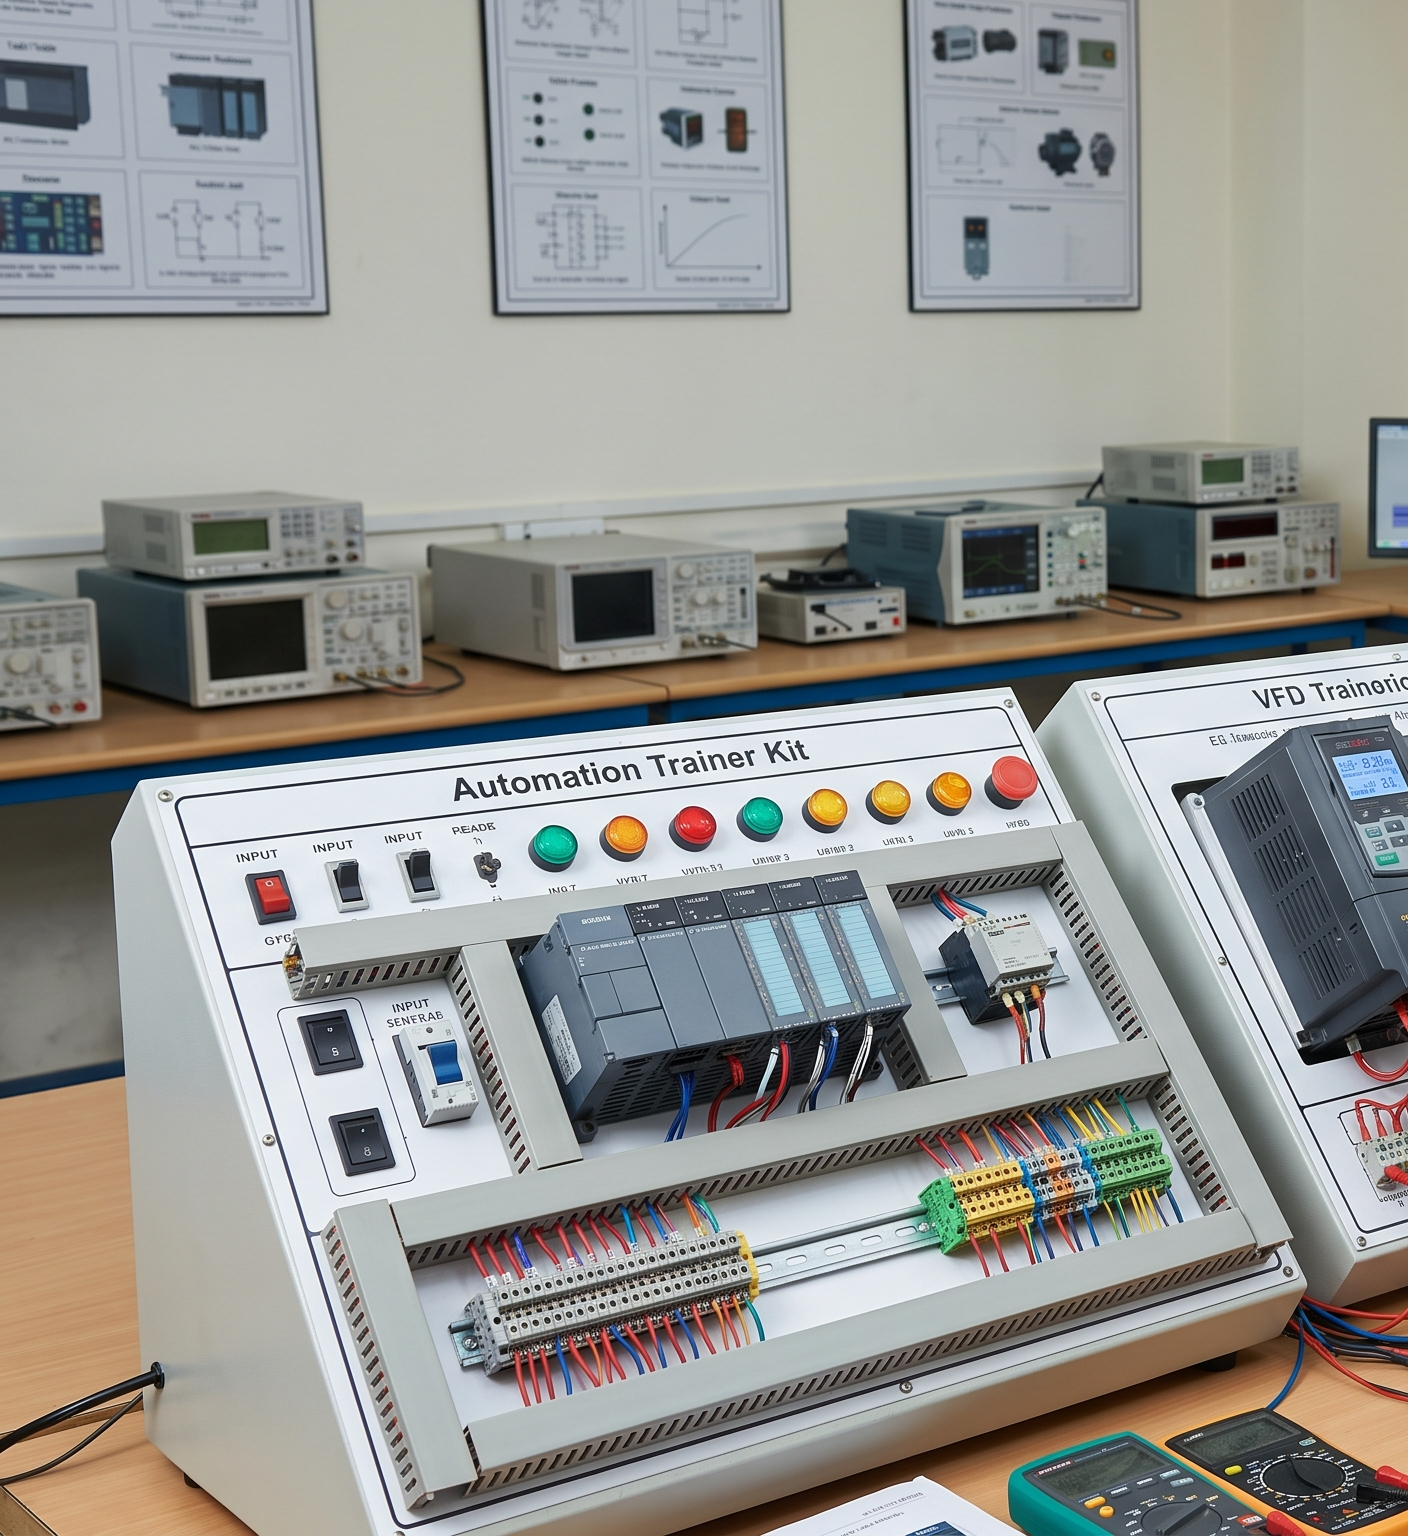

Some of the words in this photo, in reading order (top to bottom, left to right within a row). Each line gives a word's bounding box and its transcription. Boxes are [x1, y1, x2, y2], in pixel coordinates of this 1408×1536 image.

[1252, 684, 1306, 710] VFD
[453, 760, 643, 803] Automation
[646, 748, 756, 779] Trainer
[763, 739, 811, 765] Kit
[384, 830, 424, 845] INPUT
[312, 839, 355, 854] INPUT
[235, 848, 279, 864] INPUT
[391, 998, 430, 1013] INPUT
